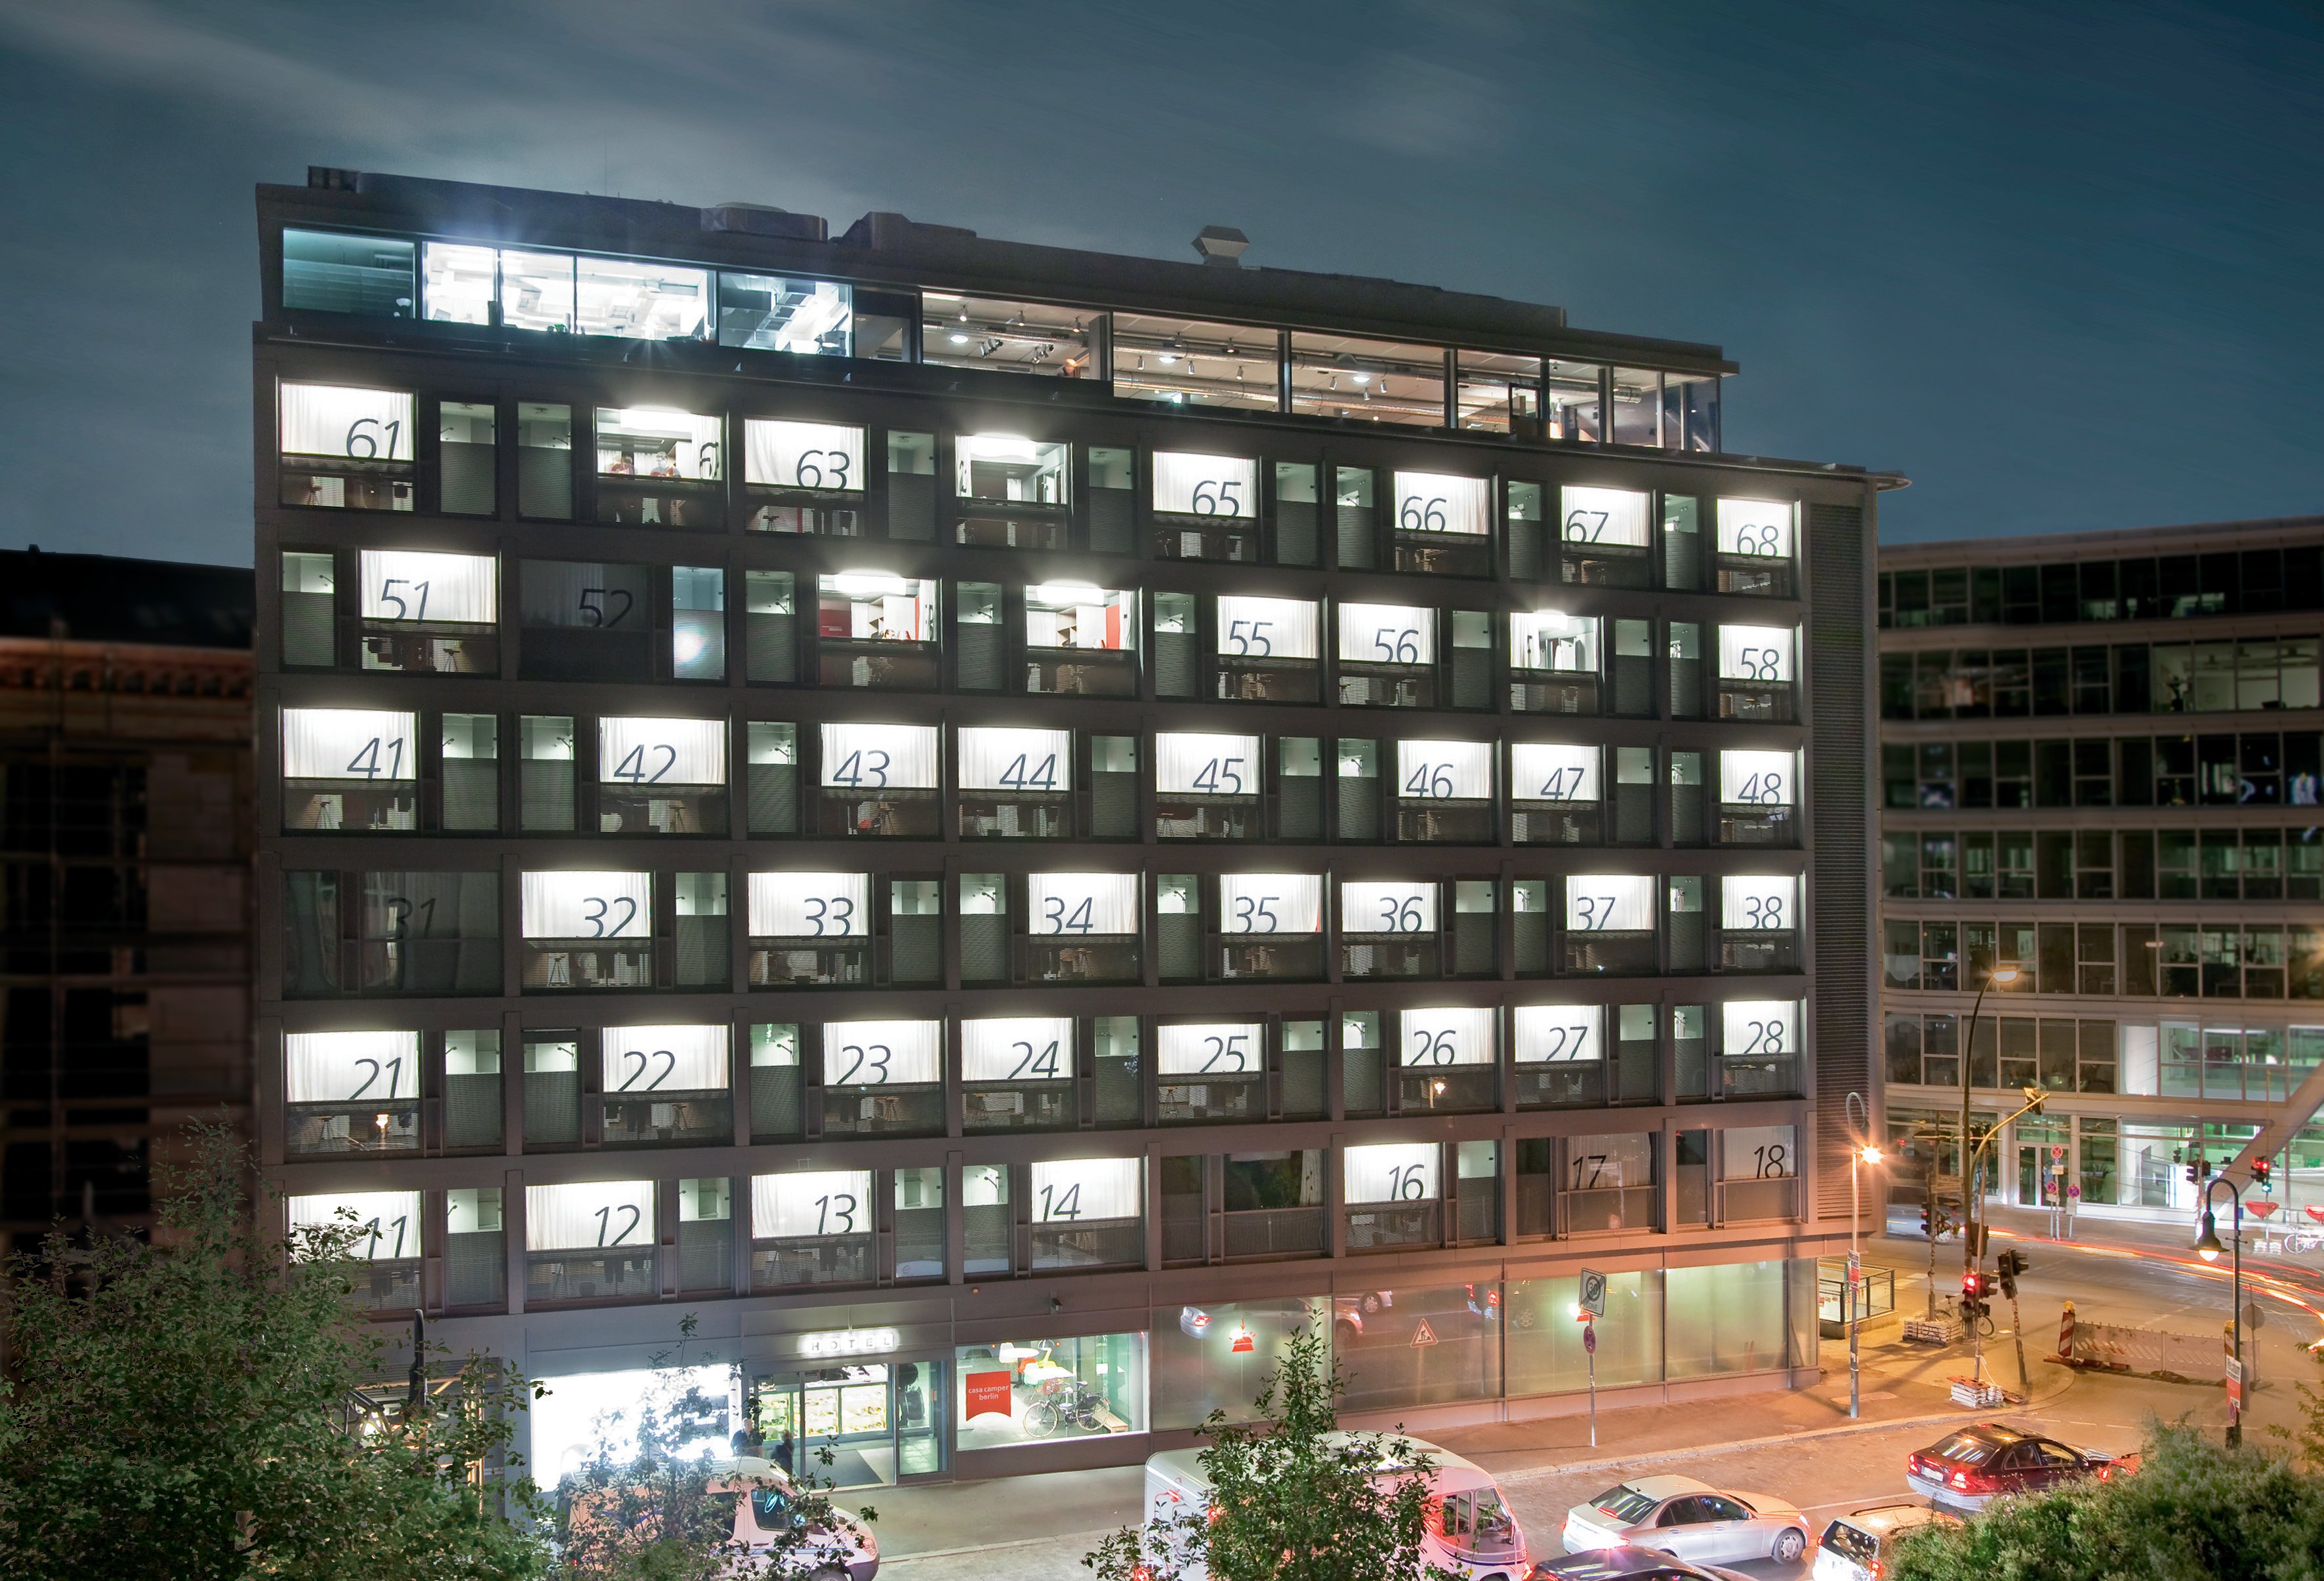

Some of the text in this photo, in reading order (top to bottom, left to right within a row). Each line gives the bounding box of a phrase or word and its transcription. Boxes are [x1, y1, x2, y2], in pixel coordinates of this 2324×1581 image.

[346, 418, 402, 458] 61
[796, 450, 850, 489] 63
[1192, 480, 1242, 517] 65
[1400, 496, 1448, 531] 66
[1566, 510, 1609, 544] 67
[1737, 525, 1779, 556] 68
[380, 579, 430, 622] 51
[578, 588, 634, 628] 52
[1229, 620, 1273, 656] 55
[1375, 629, 1419, 663] 56
[1741, 648, 1780, 681] 58
[347, 737, 404, 779] 41
[613, 744, 676, 784] 42
[832, 750, 891, 788] 43
[999, 753, 1057, 790] 44
[1193, 759, 1244, 794] 45
[1406, 763, 1454, 798] 46
[1540, 767, 1585, 800] 47
[1738, 772, 1782, 804] 48
[387, 897, 437, 938] 31
[579, 897, 637, 938] 32
[804, 897, 853, 936] 33
[1038, 896, 1093, 934] 34
[1230, 896, 1279, 933] 35
[1374, 896, 1423, 932] 36
[1576, 896, 1616, 930] 37
[1745, 896, 1783, 929] 38
[1199, 1035, 1248, 1072] 25
[1410, 1030, 1456, 1066] 26
[1545, 1026, 1588, 1060] 27
[1743, 1020, 1784, 1054] 28
[348, 1057, 401, 1099] 21
[618, 1051, 675, 1091] 22
[836, 1045, 891, 1085] 23
[1007, 1041, 1059, 1079] 24
[1572, 1155, 1606, 1189] 17
[1753, 1144, 1785, 1178] 18
[1389, 1164, 1425, 1201] 16
[815, 1193, 857, 1233] 13
[1040, 1183, 1081, 1221] 14
[364, 1215, 407, 1258] 11
[594, 1205, 640, 1247] 12
[811, 1336, 891, 1351] HOTEL
